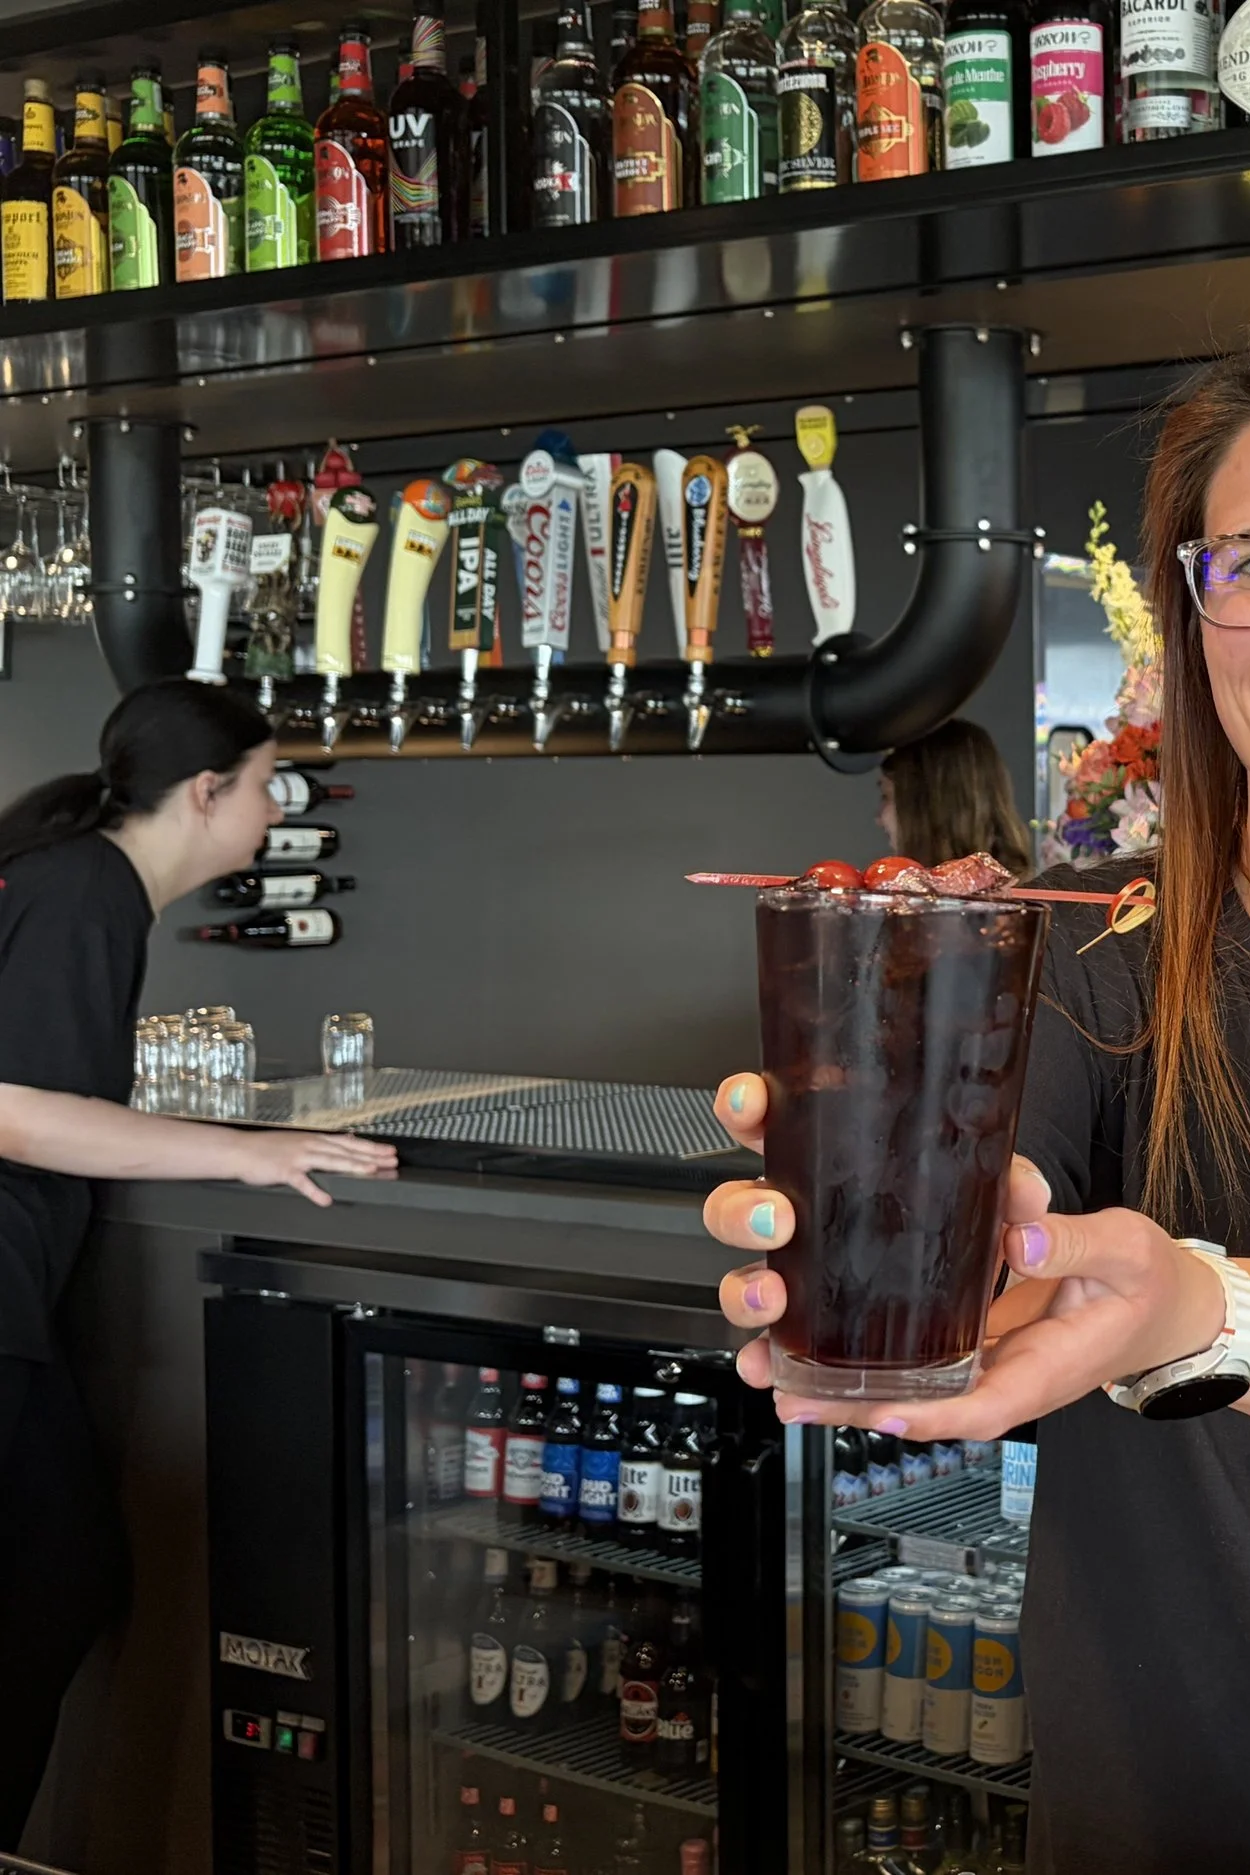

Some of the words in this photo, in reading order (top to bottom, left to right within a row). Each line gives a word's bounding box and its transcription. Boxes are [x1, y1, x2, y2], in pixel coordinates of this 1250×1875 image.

[1032, 59, 1085, 81] aspberry
[389, 113, 433, 140] UV
[523, 503, 551, 620] Coors
[556, 514, 572, 570] LIGHT
[457, 535, 480, 595] IPA
[483, 548, 498, 580] ALL
[481, 582, 497, 621] DAY
